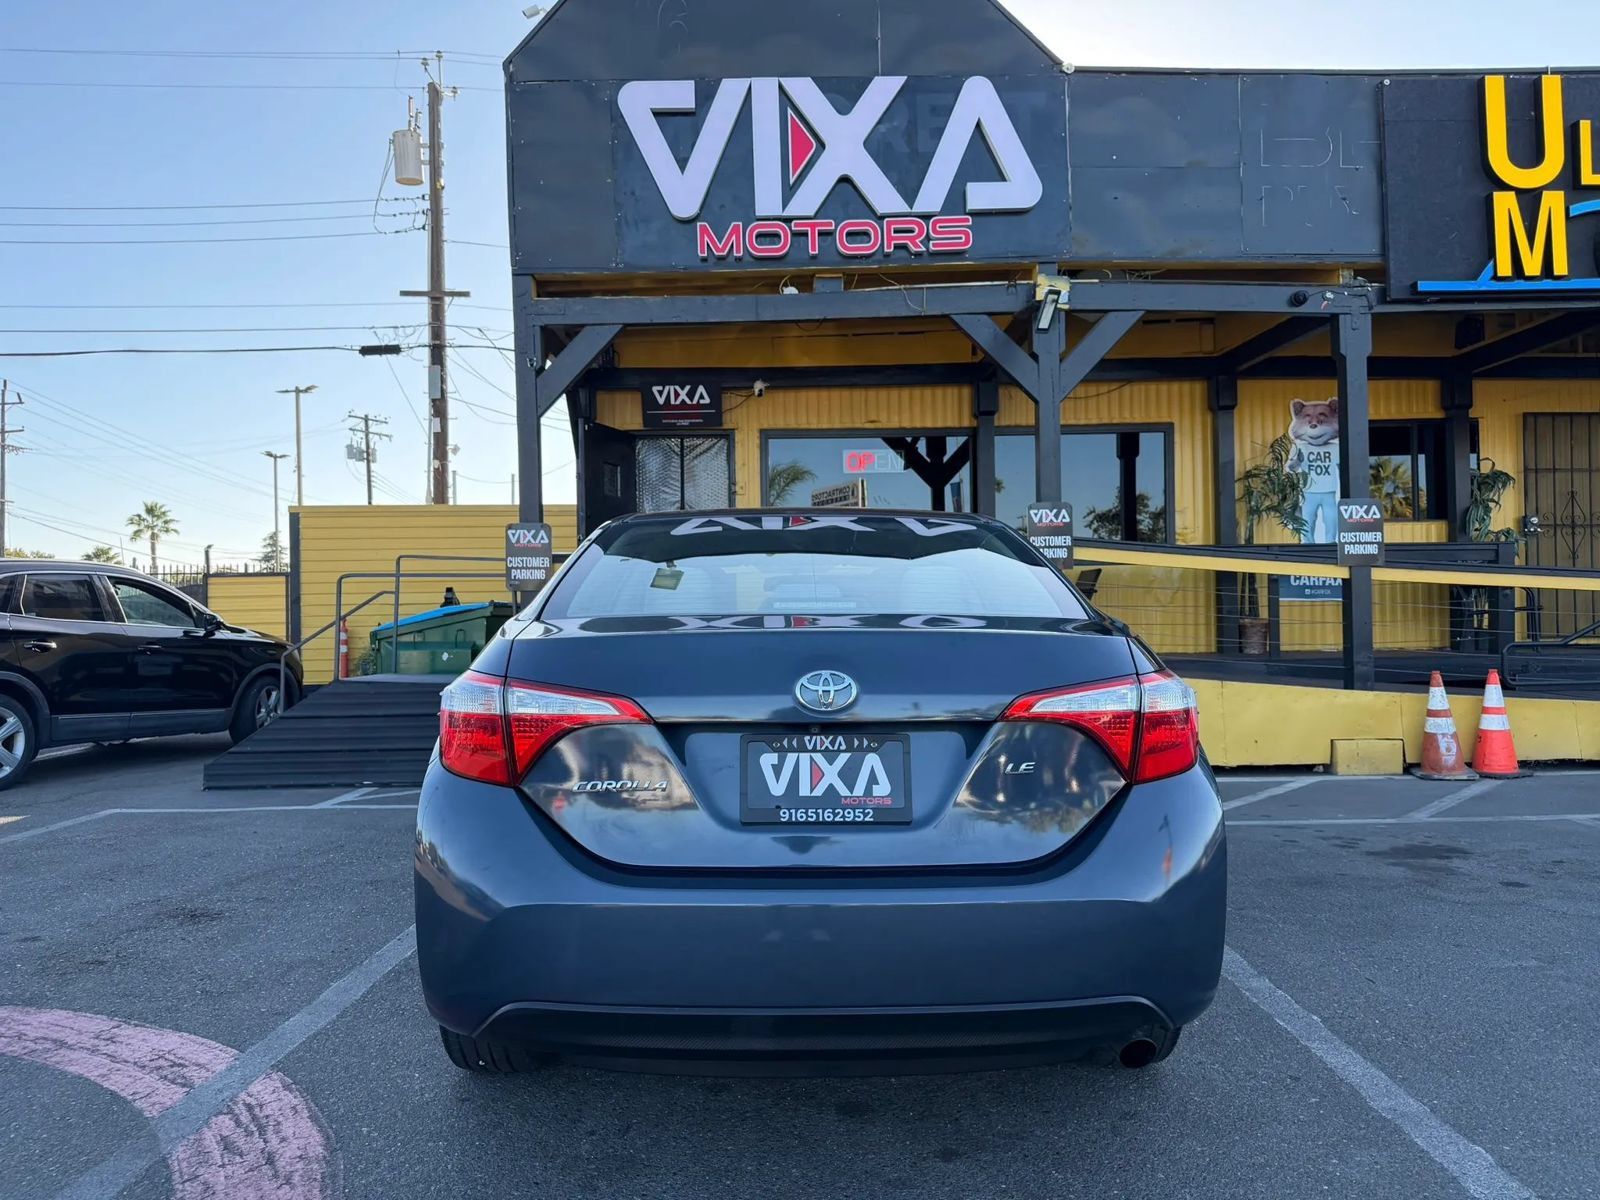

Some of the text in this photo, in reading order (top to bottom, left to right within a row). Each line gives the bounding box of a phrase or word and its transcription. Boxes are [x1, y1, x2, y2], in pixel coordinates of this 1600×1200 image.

[617, 75, 1043, 221] VIXA
[697, 215, 973, 257] MOTORS
[651, 384, 711, 406] VIXA
[846, 451, 903, 472] OPEN
[1307, 451, 1332, 464] CAR
[1307, 464, 1331, 476] FOX
[1029, 508, 1071, 523] VIXA
[1339, 504, 1381, 519] VIXA
[507, 529, 550, 544] VIXA
[1029, 535, 1072, 547] CUSTOMER
[1340, 531, 1382, 543] CUSTOMER
[1344, 543, 1379, 555] PARKING
[507, 556, 550, 568] CUSTOMER
[511, 569, 546, 580] PARKING
[804, 735, 847, 750] VIXA
[759, 752, 892, 797] VIXA
[1004, 761, 1036, 775] LE
[572, 780, 668, 793] COROLLA
[841, 797, 893, 806] MOTORS
[779, 808, 874, 822] 9165162952
